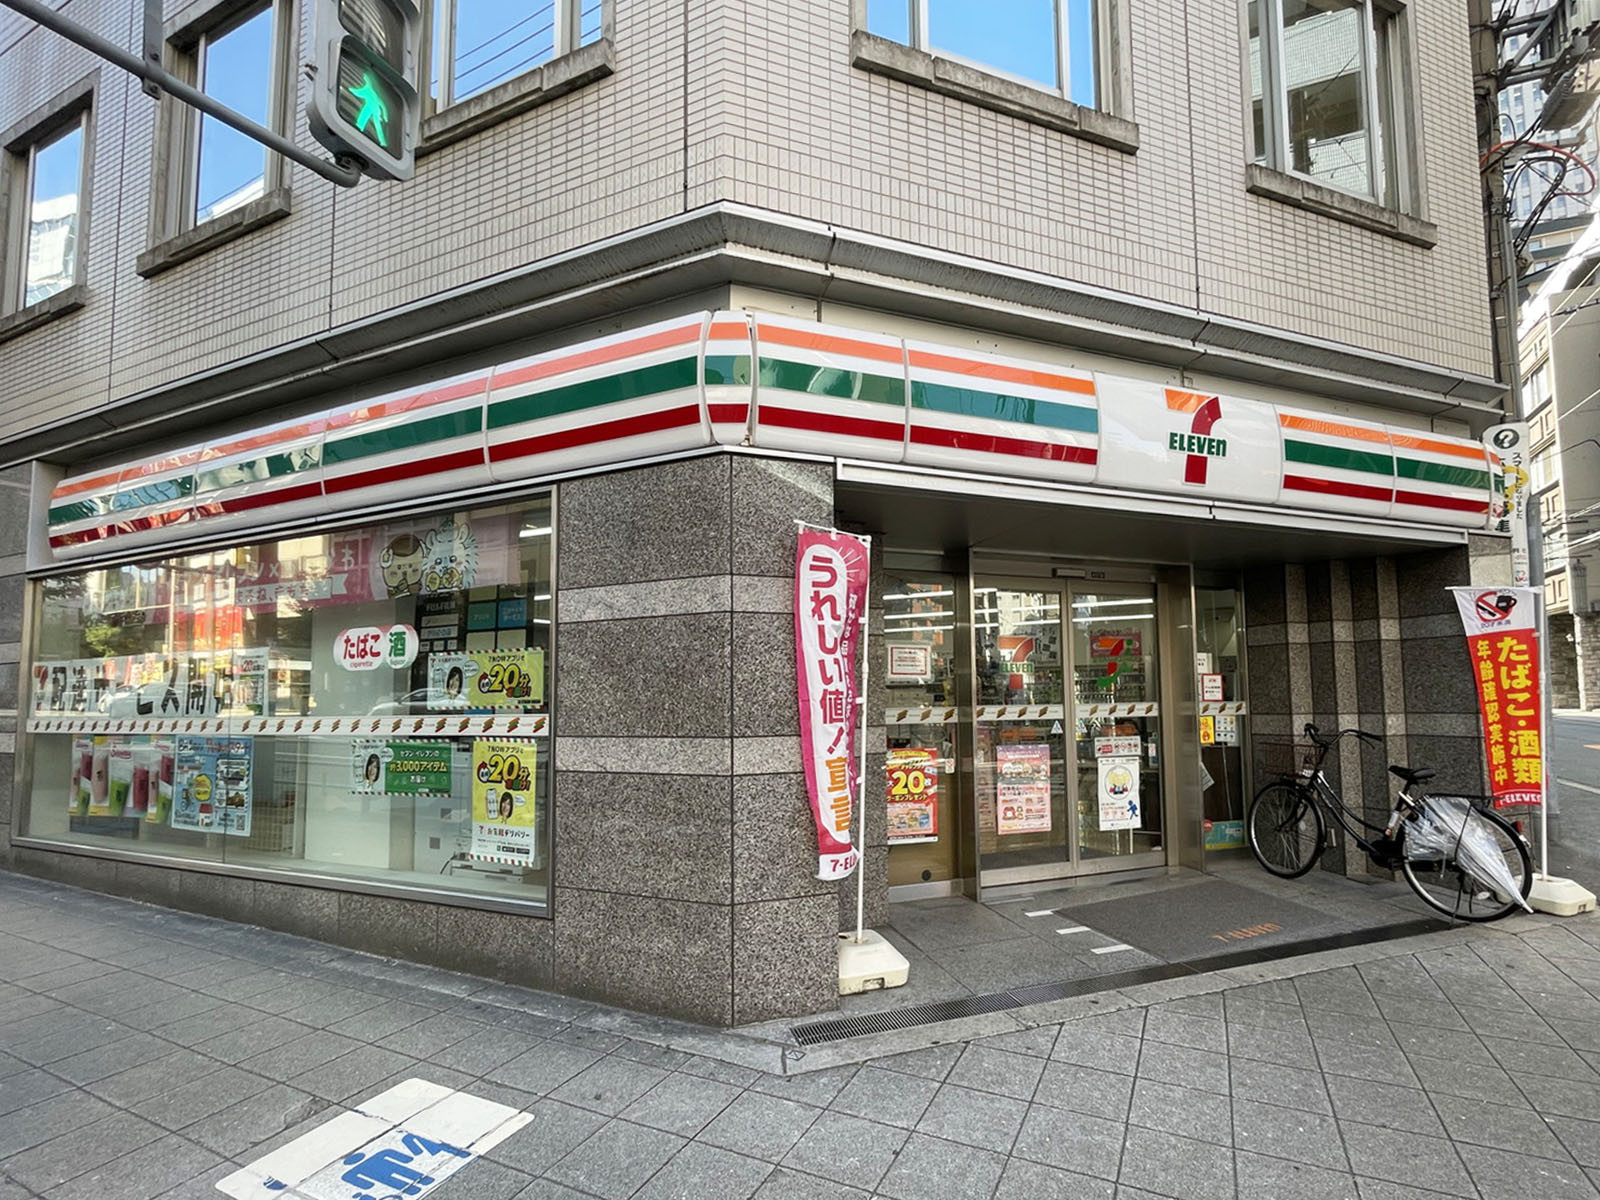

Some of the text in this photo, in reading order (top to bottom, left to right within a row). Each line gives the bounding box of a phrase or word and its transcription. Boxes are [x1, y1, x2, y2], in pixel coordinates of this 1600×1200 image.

[343, 633, 382, 660] たばこ
[389, 631, 407, 658] 酒
[1476, 639, 1508, 786] 年齢確認実施中
